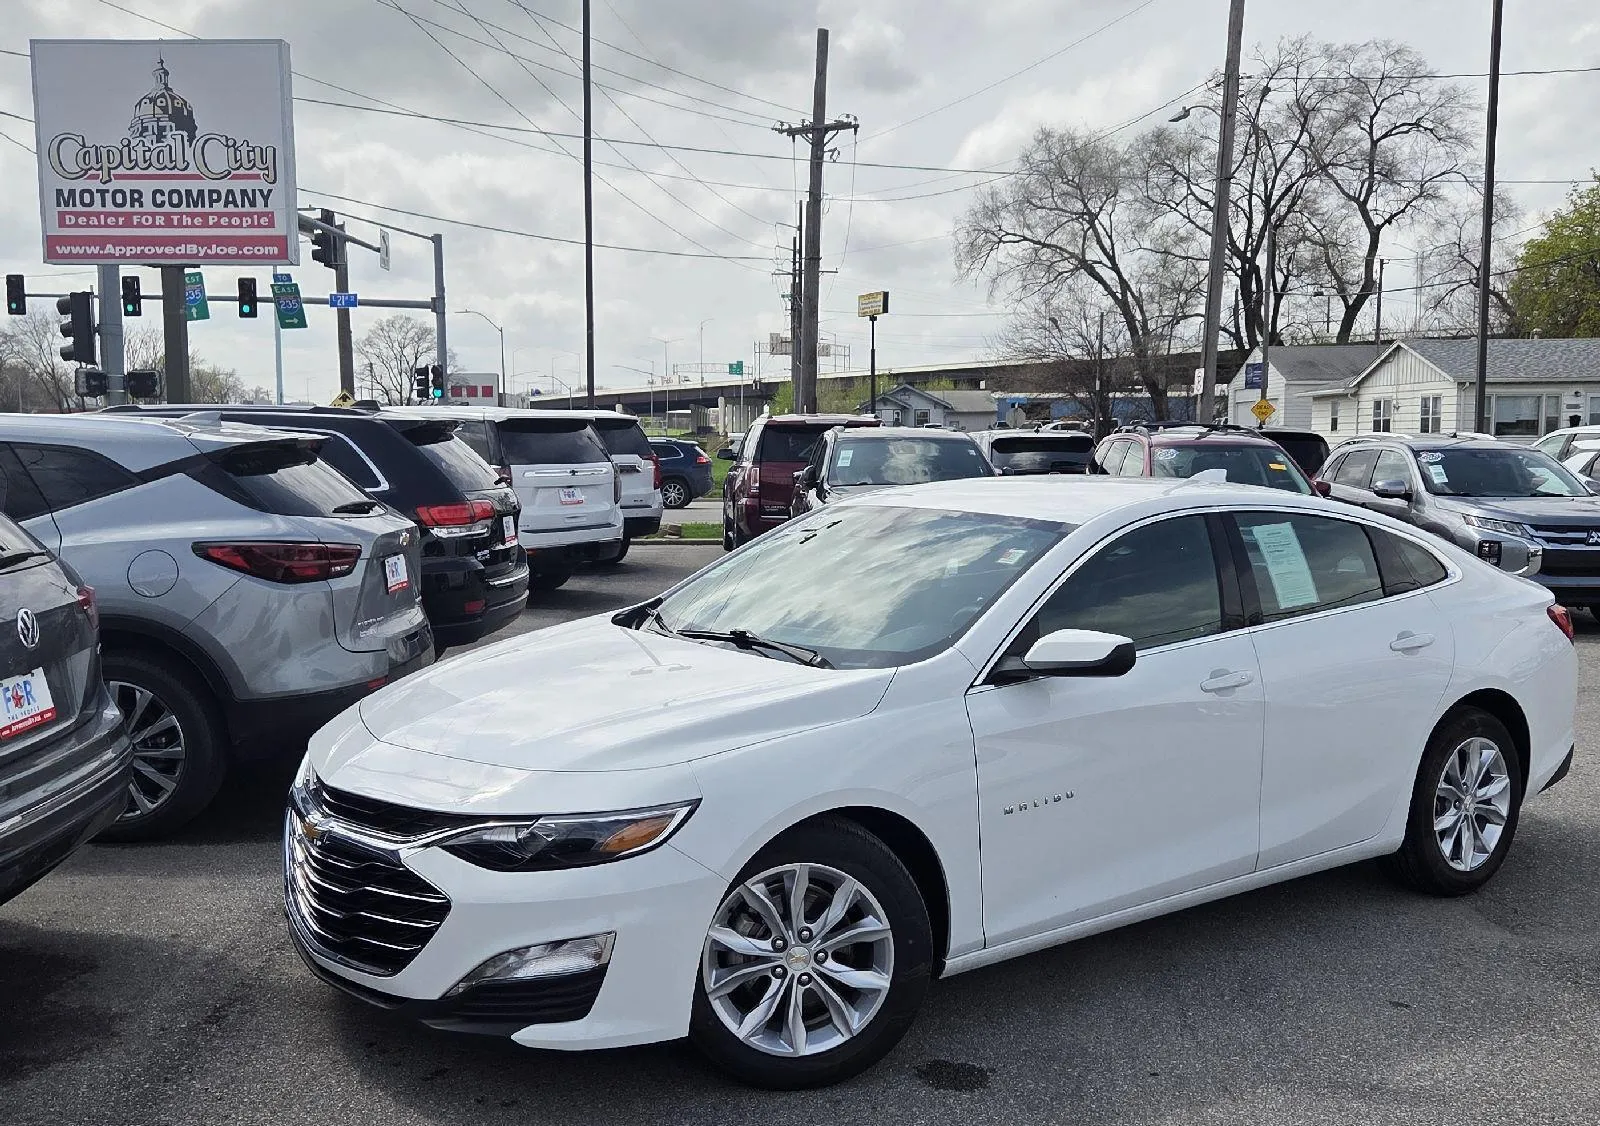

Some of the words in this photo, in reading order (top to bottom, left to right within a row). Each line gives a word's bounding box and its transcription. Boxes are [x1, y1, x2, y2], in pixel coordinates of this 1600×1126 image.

[48, 132, 190, 184] Capital
[193, 132, 278, 184] City
[55, 188, 144, 208] MOTOR
[151, 188, 273, 208] COMPANY
[65, 214, 125, 226] Dealer
[132, 214, 165, 226] FOR
[171, 214, 204, 226] The
[208, 214, 270, 228] People
[56, 243, 279, 257] www.ApprovedByJoe.com
[185, 275, 200, 284] EST
[274, 286, 296, 294] EAST
[279, 299, 299, 309] 235
[2, 680, 37, 713] FOR
[1003, 790, 1075, 815] MALIBU
